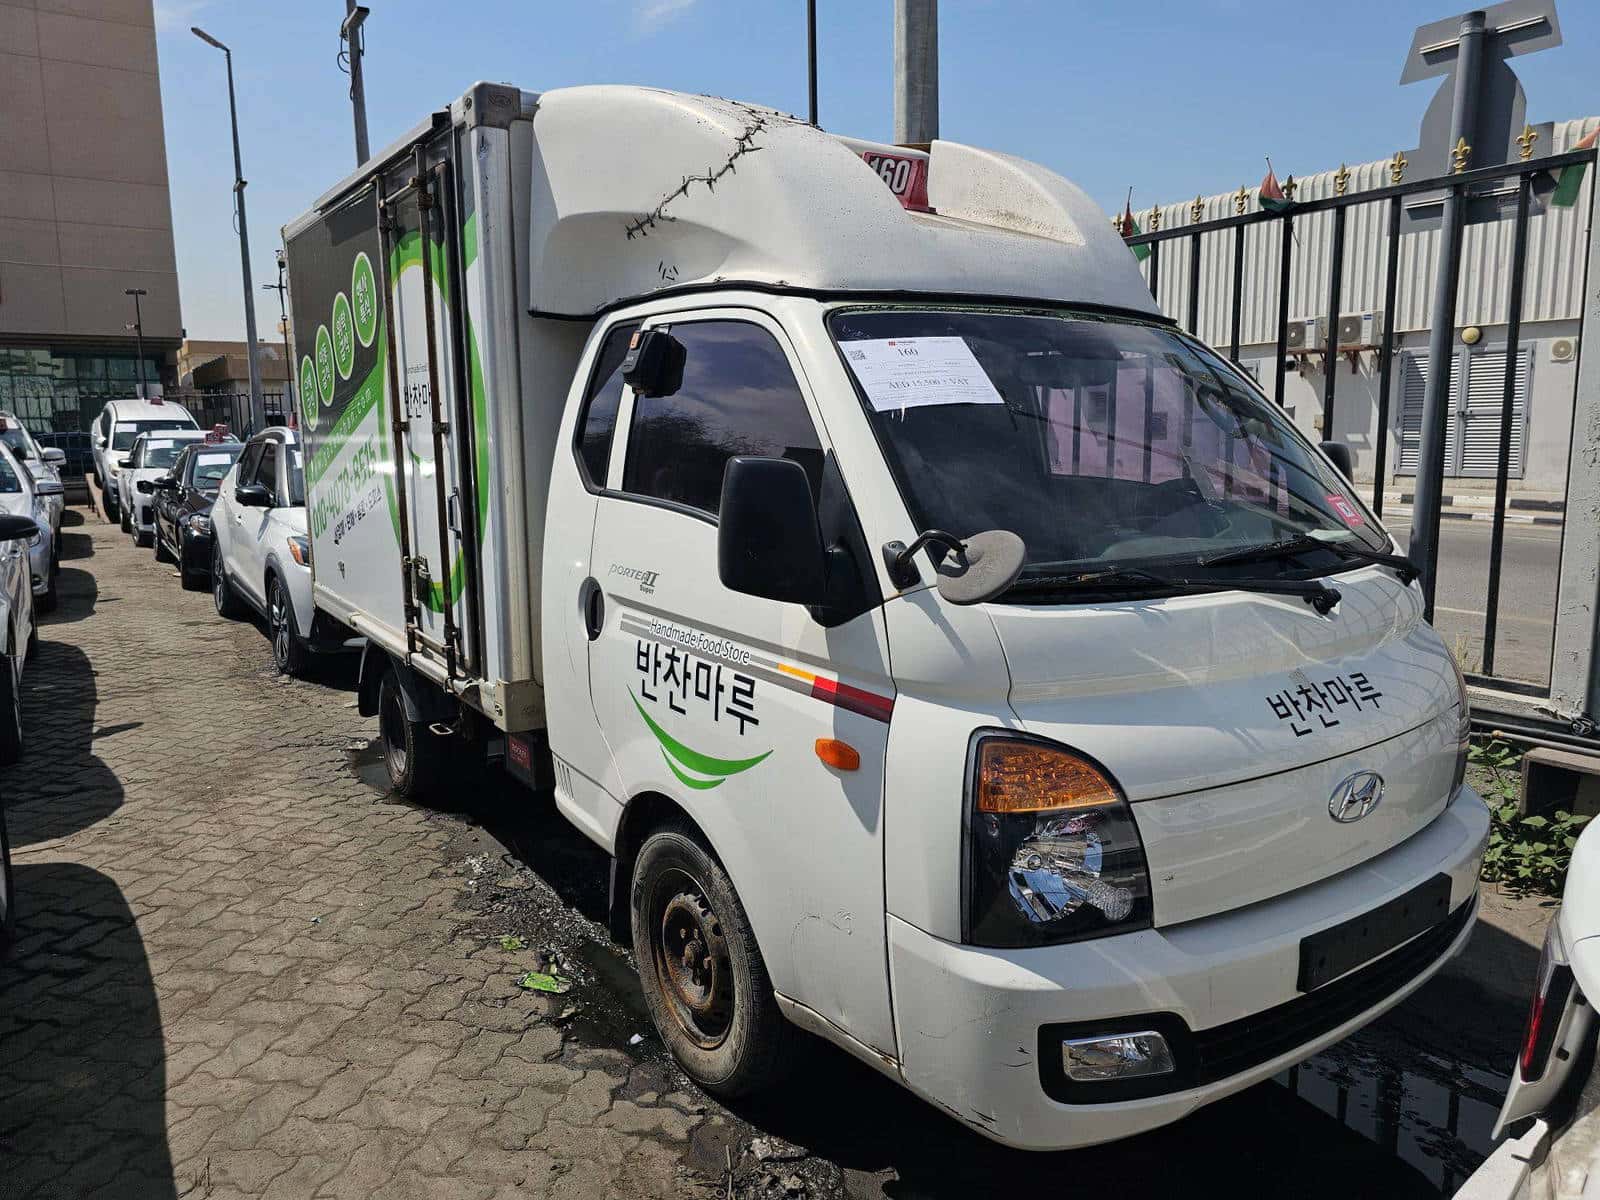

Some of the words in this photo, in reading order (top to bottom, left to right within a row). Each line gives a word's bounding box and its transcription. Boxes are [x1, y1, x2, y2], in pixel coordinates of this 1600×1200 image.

[870, 157, 911, 194] 160
[649, 618, 697, 647] Handmade
[697, 633, 723, 655] Food
[722, 641, 750, 665] Store
[636, 639, 760, 736] 반찬마루
[1265, 671, 1383, 738] 반찬마루
